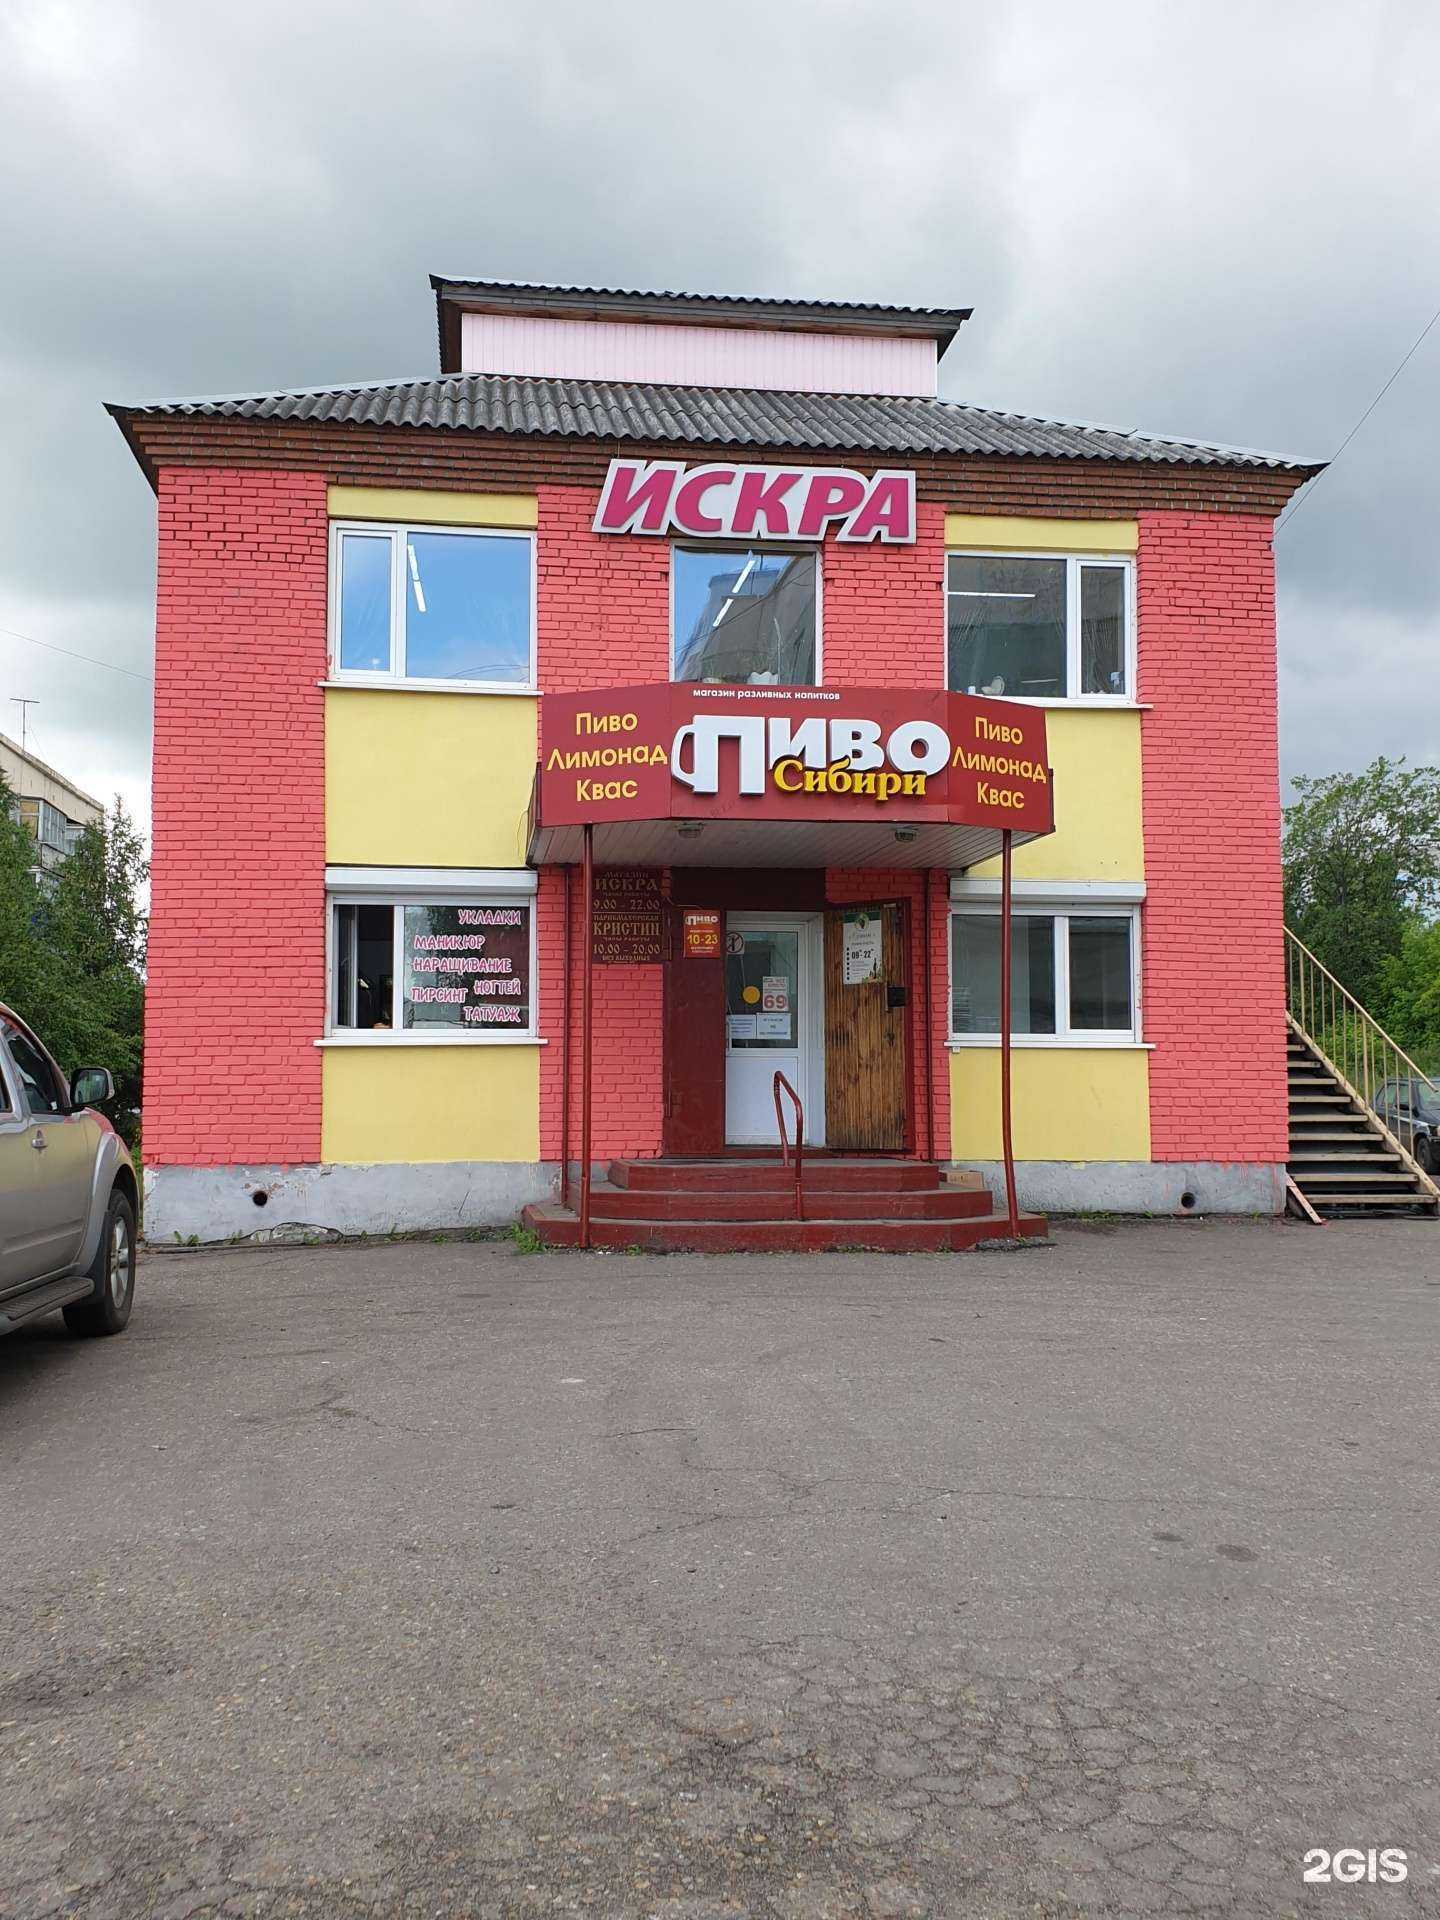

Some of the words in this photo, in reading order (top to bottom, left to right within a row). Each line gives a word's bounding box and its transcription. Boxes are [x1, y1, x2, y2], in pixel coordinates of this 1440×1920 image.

[598, 464, 912, 540] ИСКРА
[693, 689, 735, 697] магазин
[737, 690, 792, 699] разливных
[794, 691, 840, 700] напитков
[575, 712, 638, 735] Пиво
[975, 716, 1023, 745] Пиво
[546, 744, 667, 771] Лимонад
[671, 714, 951, 796] ПИВО
[952, 746, 1047, 784] Лимонад
[773, 758, 927, 801] Сибири
[576, 778, 638, 802] Квас
[977, 781, 1025, 809] Квас
[595, 878, 659, 890] ИСКРА
[593, 899, 617, 909] 9.00
[458, 909, 521, 925] УКЛАДКИ
[593, 922, 660, 936] КРИСТИН
[414, 935, 485, 950] МАНИКЮР
[593, 944, 620, 954] 10.00
[631, 944, 660, 954] 20.00
[413, 957, 512, 975] НАРАЩИВАНИЕ
[411, 987, 468, 1003] ПИРСИНГ
[474, 978, 521, 995] НОГТЕЙ
[763, 994, 787, 1009] 69
[463, 1005, 521, 1022] ТАТУАЖ
